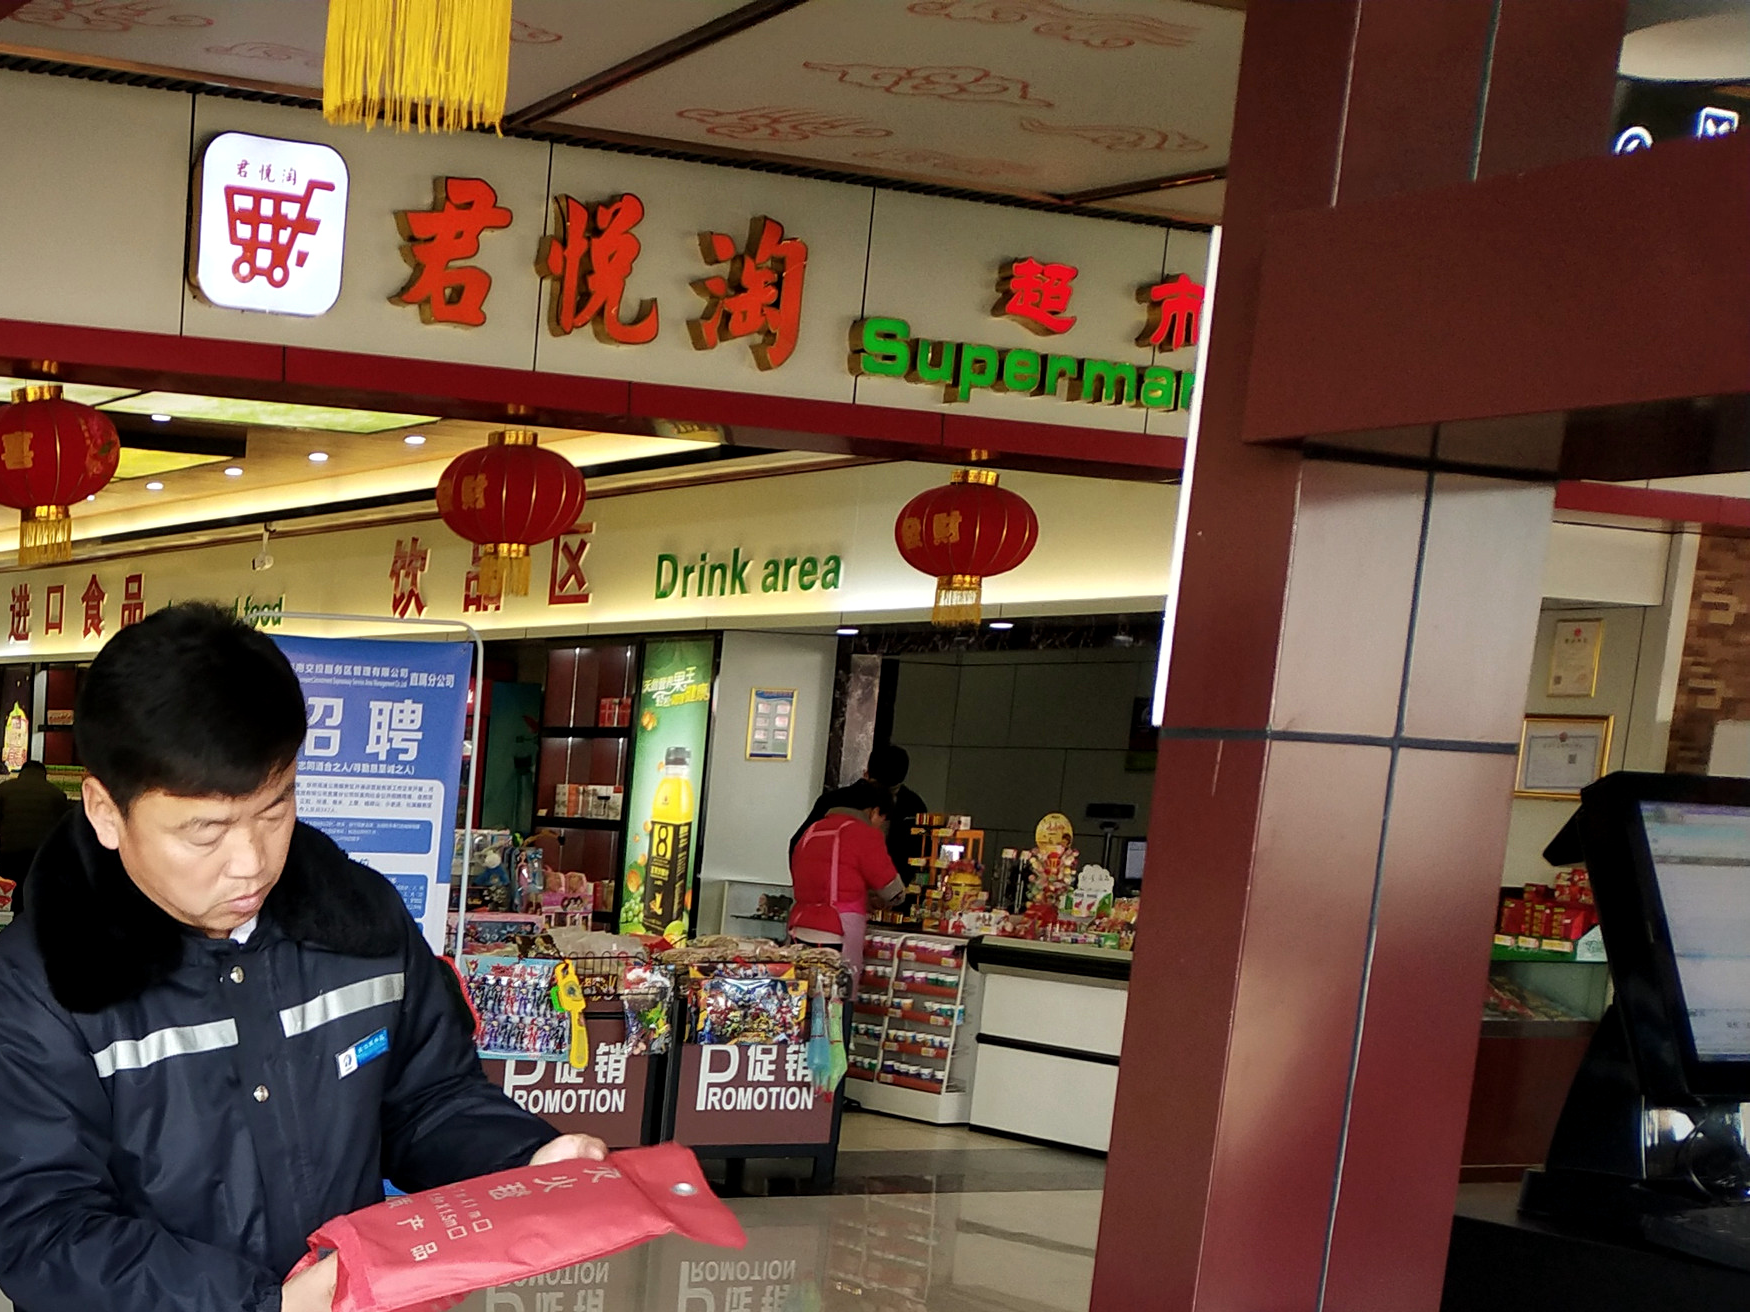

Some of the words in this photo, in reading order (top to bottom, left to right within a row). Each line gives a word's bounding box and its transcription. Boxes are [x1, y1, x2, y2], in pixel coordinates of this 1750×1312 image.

[392, 175, 807, 370] 君悦淘
[1005, 256, 1205, 352] 超市
[8, 573, 145, 641] 进口食品
[655, 547, 752, 600] Drink
[761, 553, 842, 593] area
[747, 1044, 813, 1082] 促销
